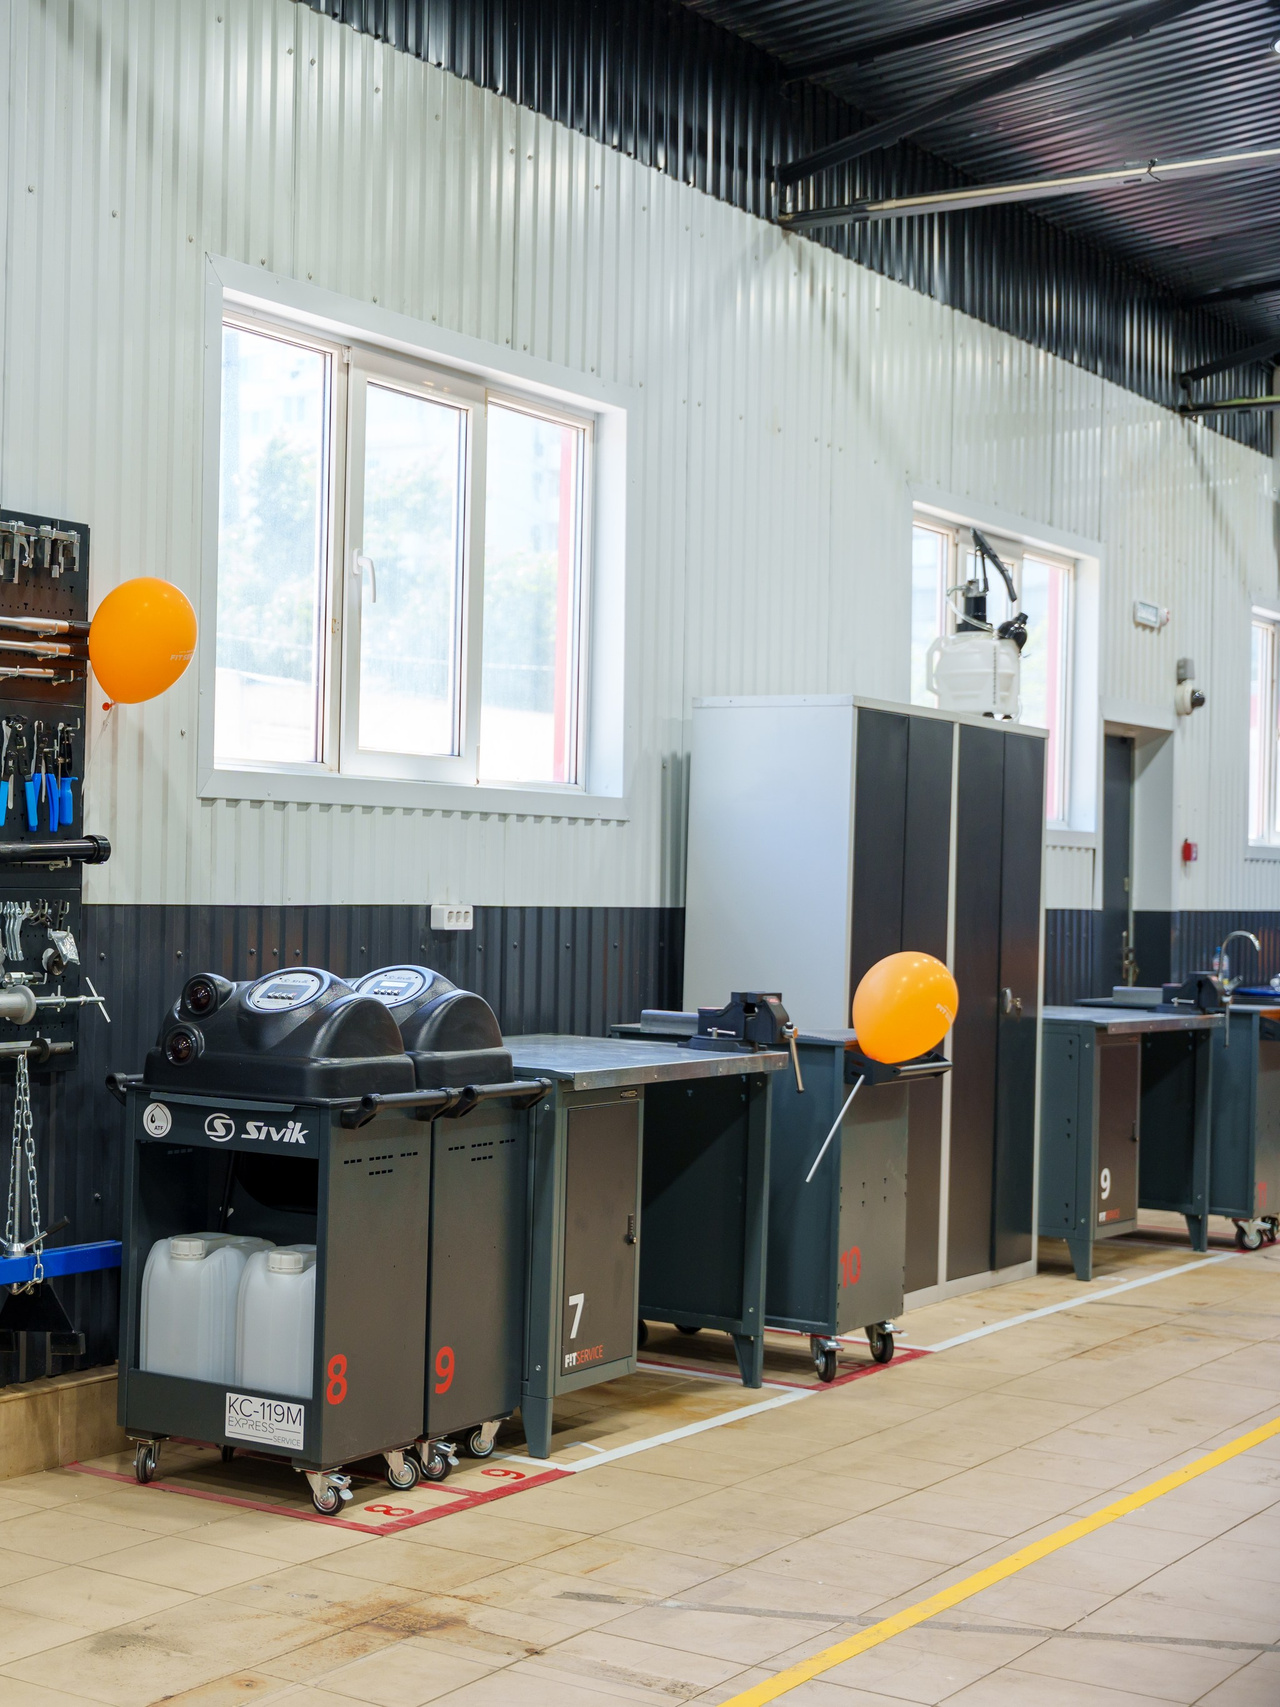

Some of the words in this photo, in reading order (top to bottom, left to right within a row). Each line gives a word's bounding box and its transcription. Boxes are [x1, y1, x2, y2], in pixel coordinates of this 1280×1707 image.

[241, 1120, 309, 1144] Sivik
[1100, 1167, 1111, 1200] 9
[840, 1245, 862, 1288] 10
[568, 1292, 585, 1340] 7
[326, 1353, 348, 1406] 8
[434, 1345, 455, 1395] 9
[228, 1395, 302, 1427] KC-119M
[228, 1415, 275, 1434] EXPRESS
[272, 1435, 301, 1447] SERVICE
[363, 1504, 415, 1517] 8
